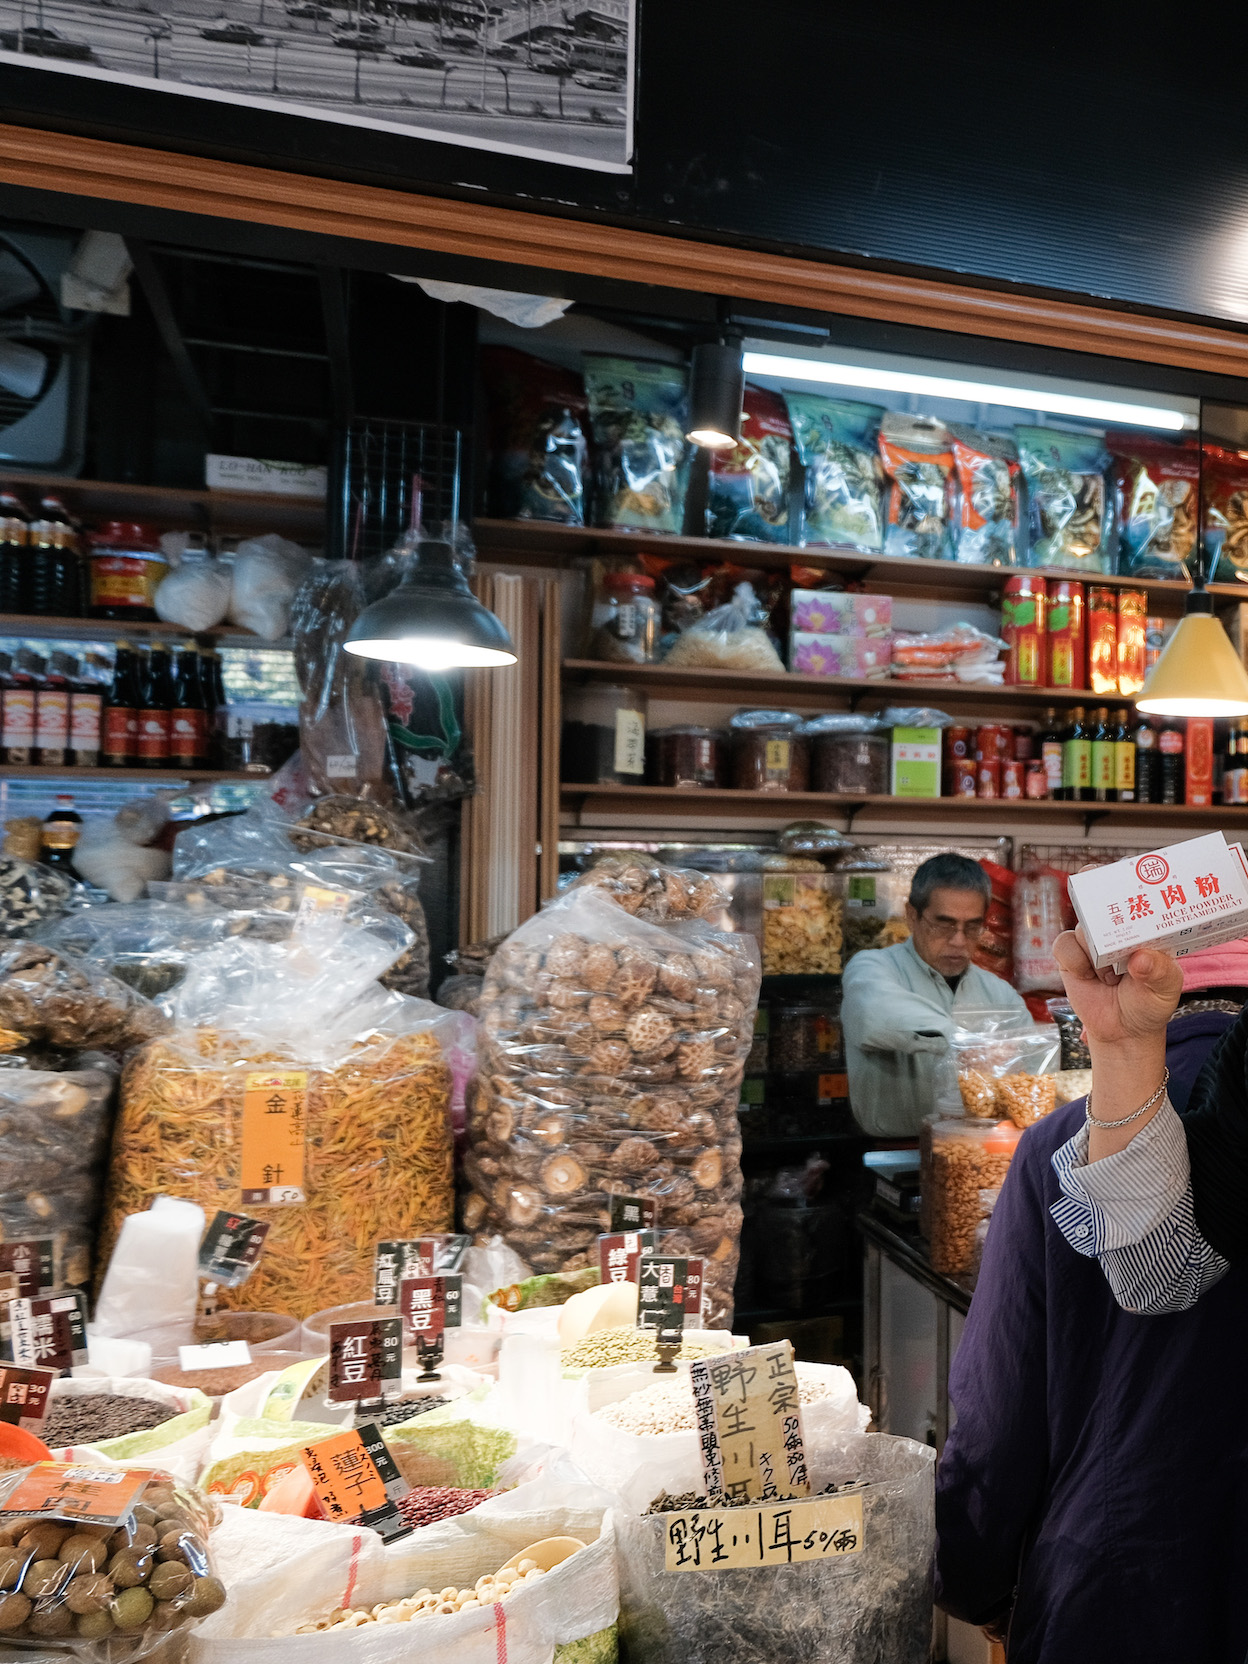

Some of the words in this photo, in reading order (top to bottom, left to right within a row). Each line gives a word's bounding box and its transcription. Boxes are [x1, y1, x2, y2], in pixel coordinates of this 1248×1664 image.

[1143, 861, 1166, 879] 瑞
[1125, 873, 1220, 921] 蒸肉粉
[1161, 906, 1188, 921] RICE
[1188, 893, 1234, 913] POWDER
[1107, 902, 1125, 926] 五香
[1155, 919, 1175, 931] FOR
[1175, 907, 1218, 925] STEAMED
[1218, 897, 1244, 912] MEAT
[281, 1190, 299, 1202] 50
[687, 1275, 700, 1284] 80
[446, 1290, 460, 1300] 60
[640, 1262, 660, 1328] 大薏仁
[410, 1288, 434, 1331] 黑豆
[384, 1337, 398, 1348] 80
[341, 1335, 368, 1384] 紅豆
[28, 1384, 47, 1394] 30
[767, 1352, 798, 1415] 正宗
[366, 1441, 385, 1455] 300
[330, 1448, 364, 1496] 蓮子
[376, 1456, 389, 1468] 元
[669, 1510, 801, 1566] 野生川耳
